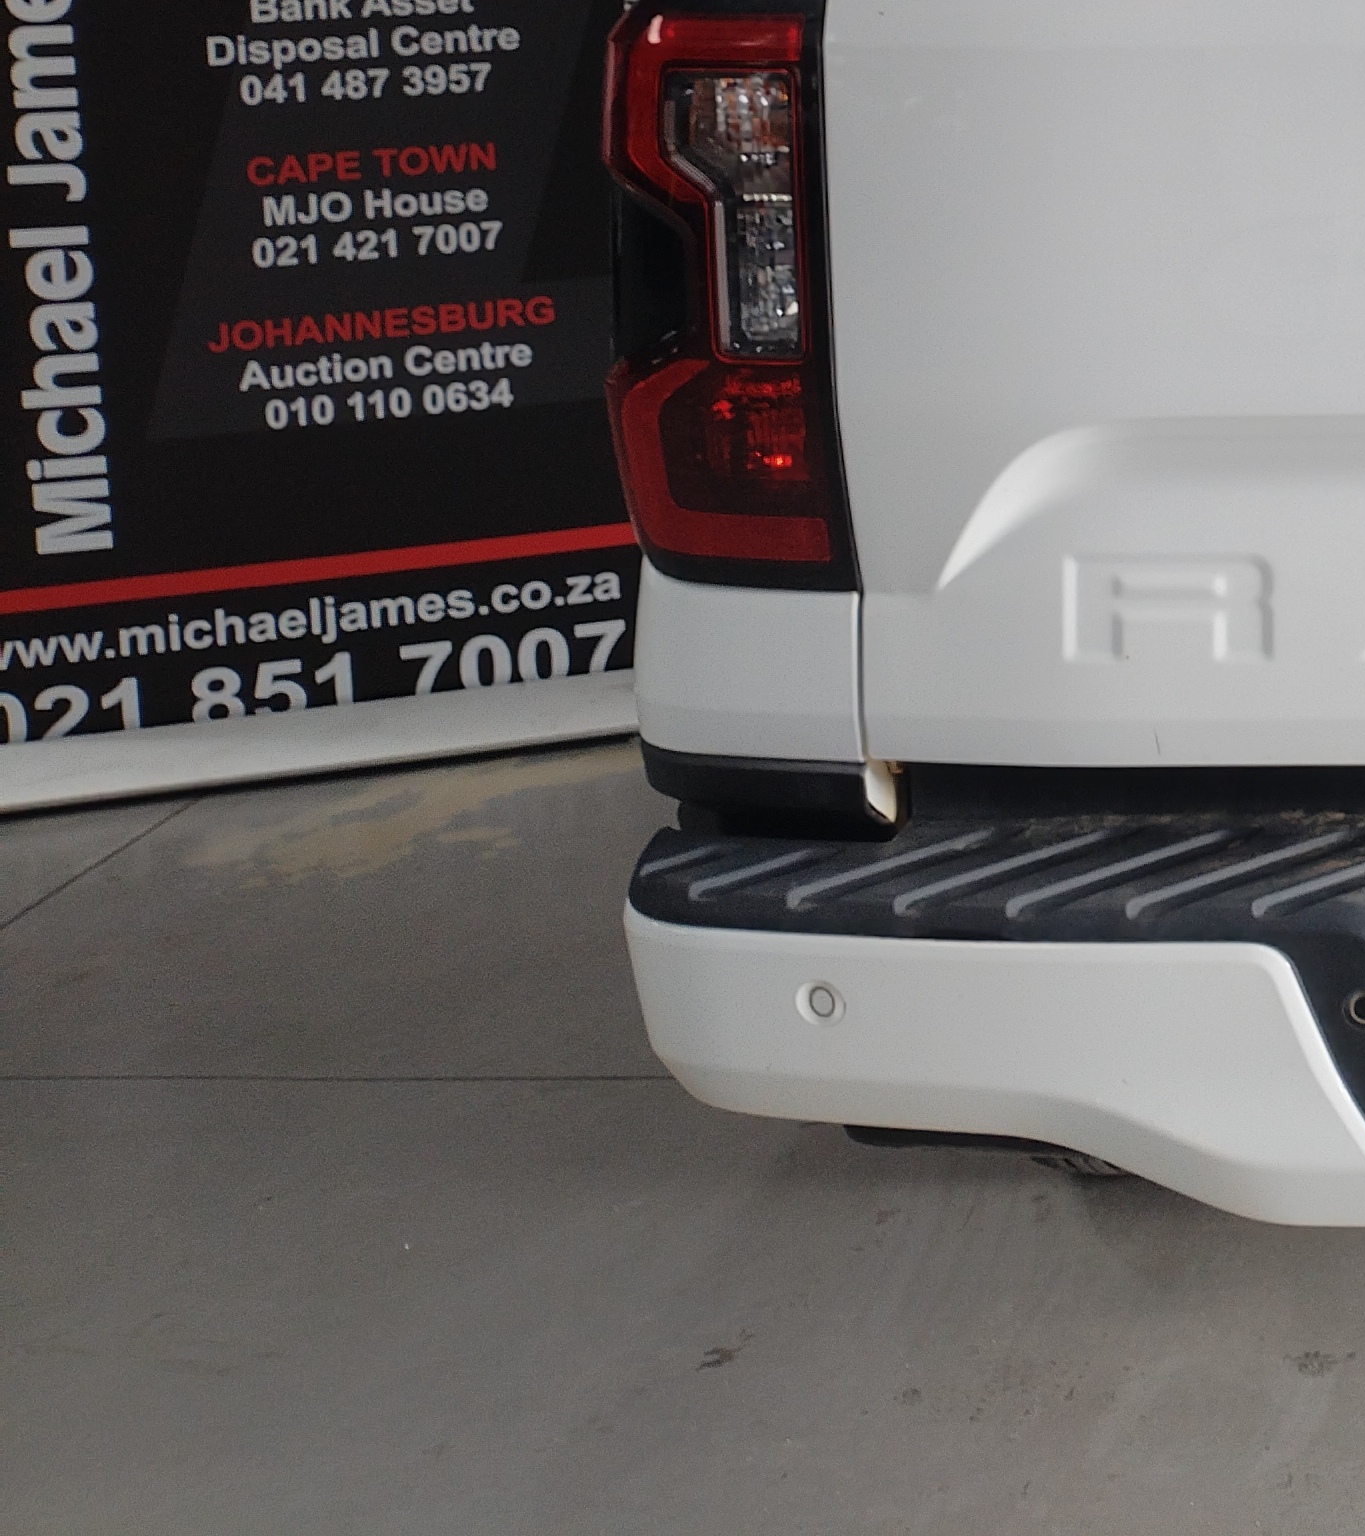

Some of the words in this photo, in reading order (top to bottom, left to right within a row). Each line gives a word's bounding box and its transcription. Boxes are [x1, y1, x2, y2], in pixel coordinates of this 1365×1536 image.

[206, 28, 379, 70] Disposal
[391, 24, 520, 56] Centre
[240, 72, 306, 105] 041
[321, 68, 390, 100] 487
[402, 62, 491, 96] 3957
[247, 151, 361, 186] CAPE
[373, 142, 496, 176] TOWN
[263, 192, 352, 226] MJO
[364, 188, 488, 219] House
[252, 234, 317, 268] 021
[333, 229, 397, 261] 421
[412, 221, 502, 255] 7007
[208, 296, 555, 352] JOHANNESBURG
[9, 226, 113, 554] Michael
[239, 353, 393, 391] Auction
[405, 342, 532, 376] Centre
[265, 395, 334, 429] 010
[347, 388, 411, 421] 110
[423, 378, 513, 414] 0634
[399, 619, 626, 696] 7007
